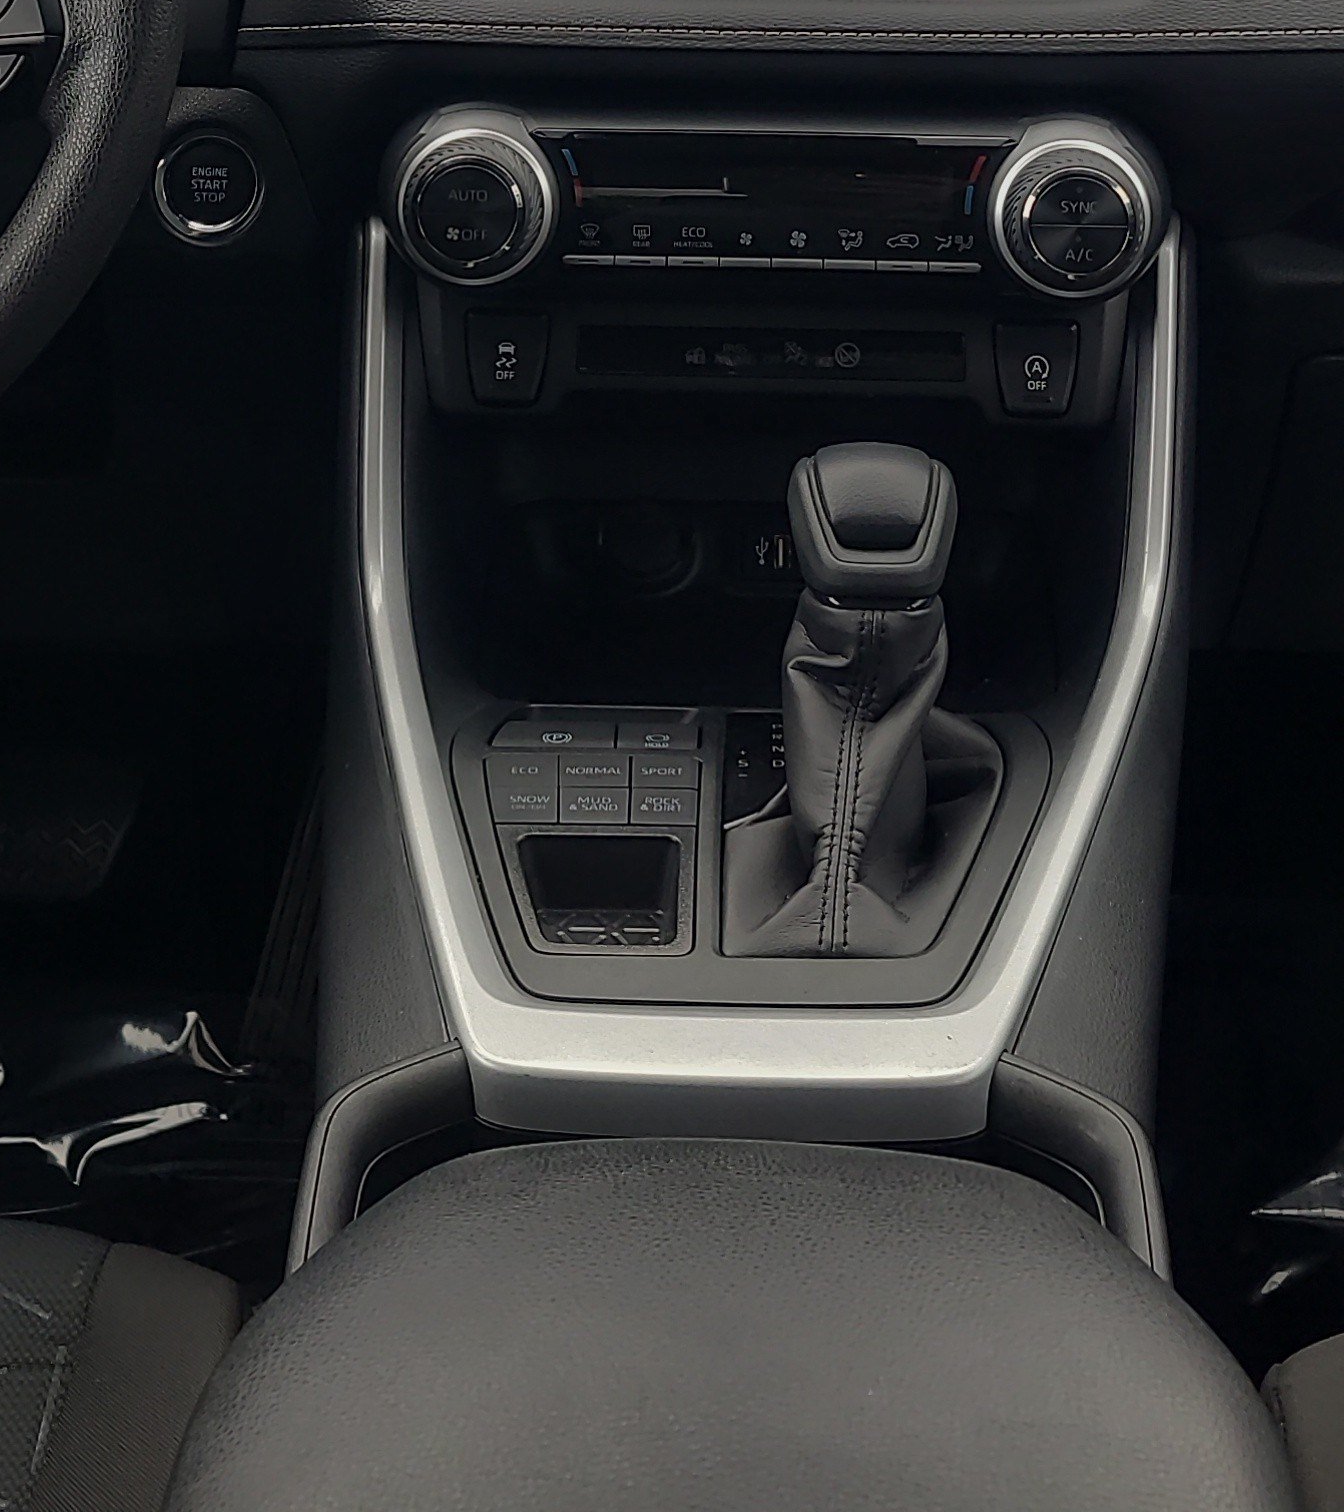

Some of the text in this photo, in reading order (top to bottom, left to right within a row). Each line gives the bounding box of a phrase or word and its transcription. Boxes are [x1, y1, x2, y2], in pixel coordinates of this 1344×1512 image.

[192, 167, 228, 177] ENGINE
[191, 179, 228, 190] START
[194, 192, 226, 203] STOP
[448, 188, 488, 202] AUTO
[1060, 200, 1097, 215] SYNC
[461, 229, 487, 241] OFF
[682, 226, 706, 238] ECO
[1065, 248, 1094, 263] A/C
[496, 370, 515, 380] OFF
[1027, 380, 1047, 390] OFF
[511, 766, 538, 775] ECO
[565, 766, 621, 775] NORMAL
[640, 767, 683, 776] SPORT
[510, 795, 550, 804] SNOW
[577, 796, 612, 805] MUD
[644, 796, 681, 805] ROCK
[581, 804, 619, 812] SAND
[652, 804, 682, 813] DIRT
